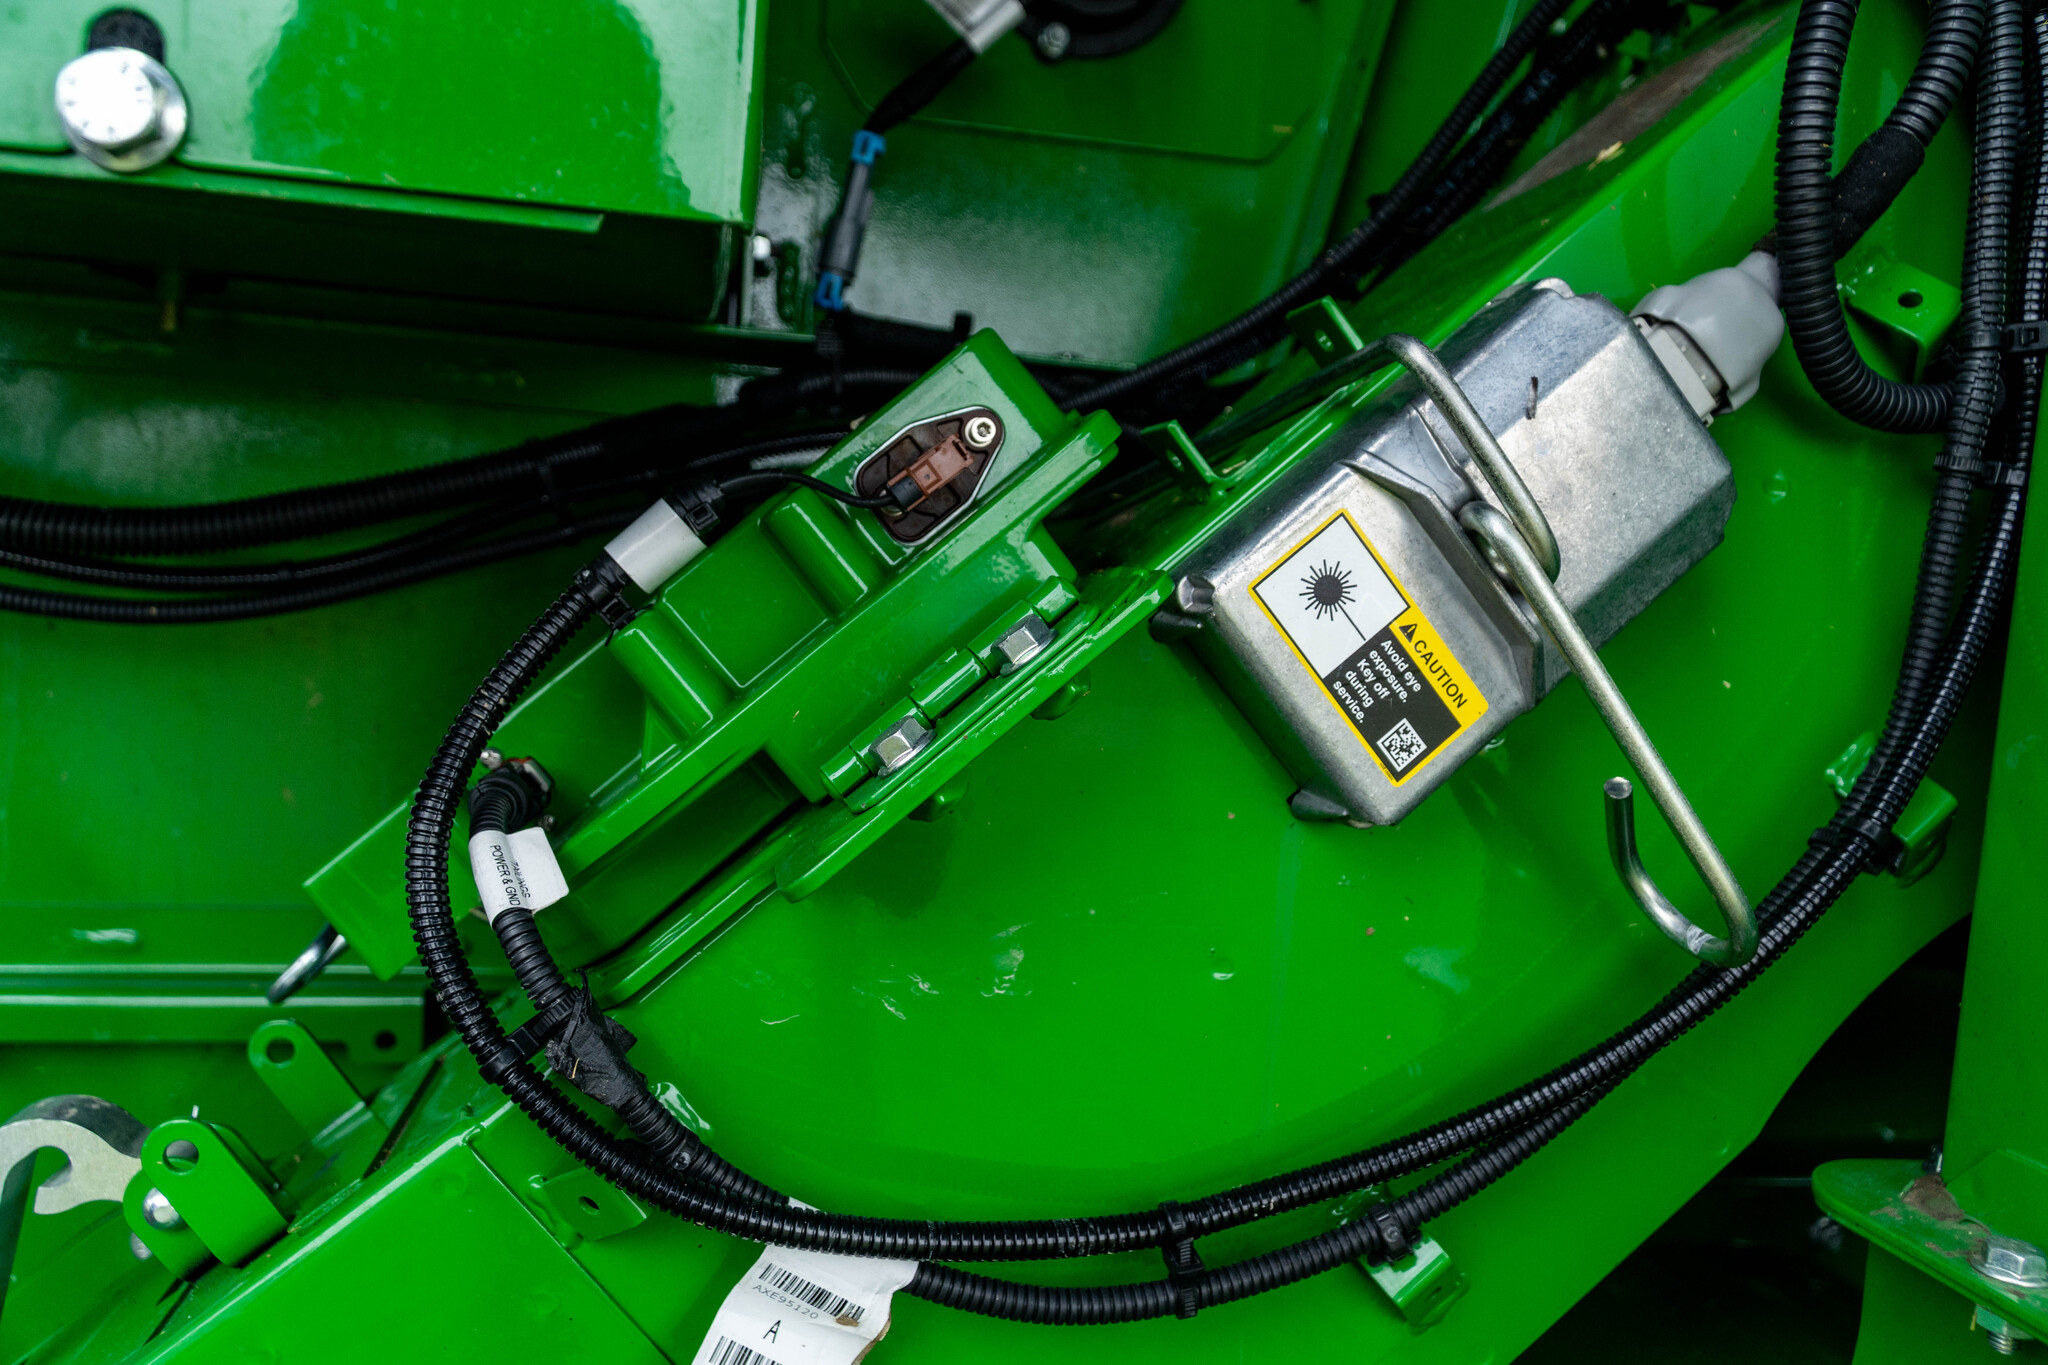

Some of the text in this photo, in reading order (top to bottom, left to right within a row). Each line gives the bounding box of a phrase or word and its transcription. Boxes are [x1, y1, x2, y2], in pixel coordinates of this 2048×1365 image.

[1357, 659, 1391, 699] Key off
[1369, 650, 1408, 703] exposure.
[1381, 640, 1421, 692] Avoid eye
[1414, 640, 1468, 709] CAUTION
[1333, 681, 1365, 723] service.
[1345, 670, 1374, 708] during
[490, 845, 511, 877] POWER
[505, 886, 521, 906] GND
[752, 1284, 819, 1319] AXE95120
[763, 1320, 782, 1344] A
